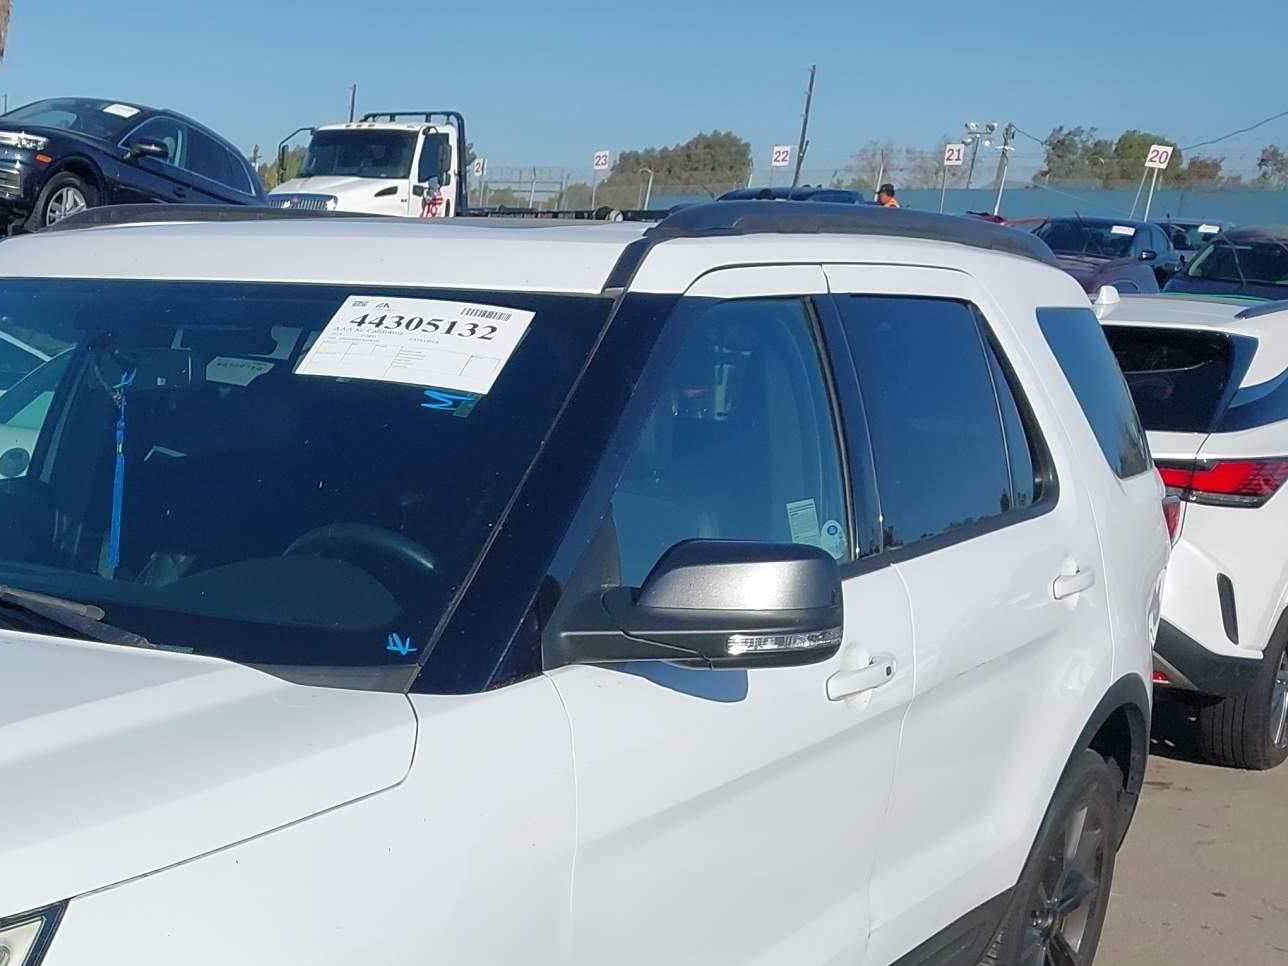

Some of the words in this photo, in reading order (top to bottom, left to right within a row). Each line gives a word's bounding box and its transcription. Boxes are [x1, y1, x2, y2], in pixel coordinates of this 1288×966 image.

[595, 154, 608, 167] 23
[773, 150, 789, 162] 22
[945, 149, 962, 161] 21
[1148, 149, 1169, 164] 20
[350, 313, 498, 340] 44305132
